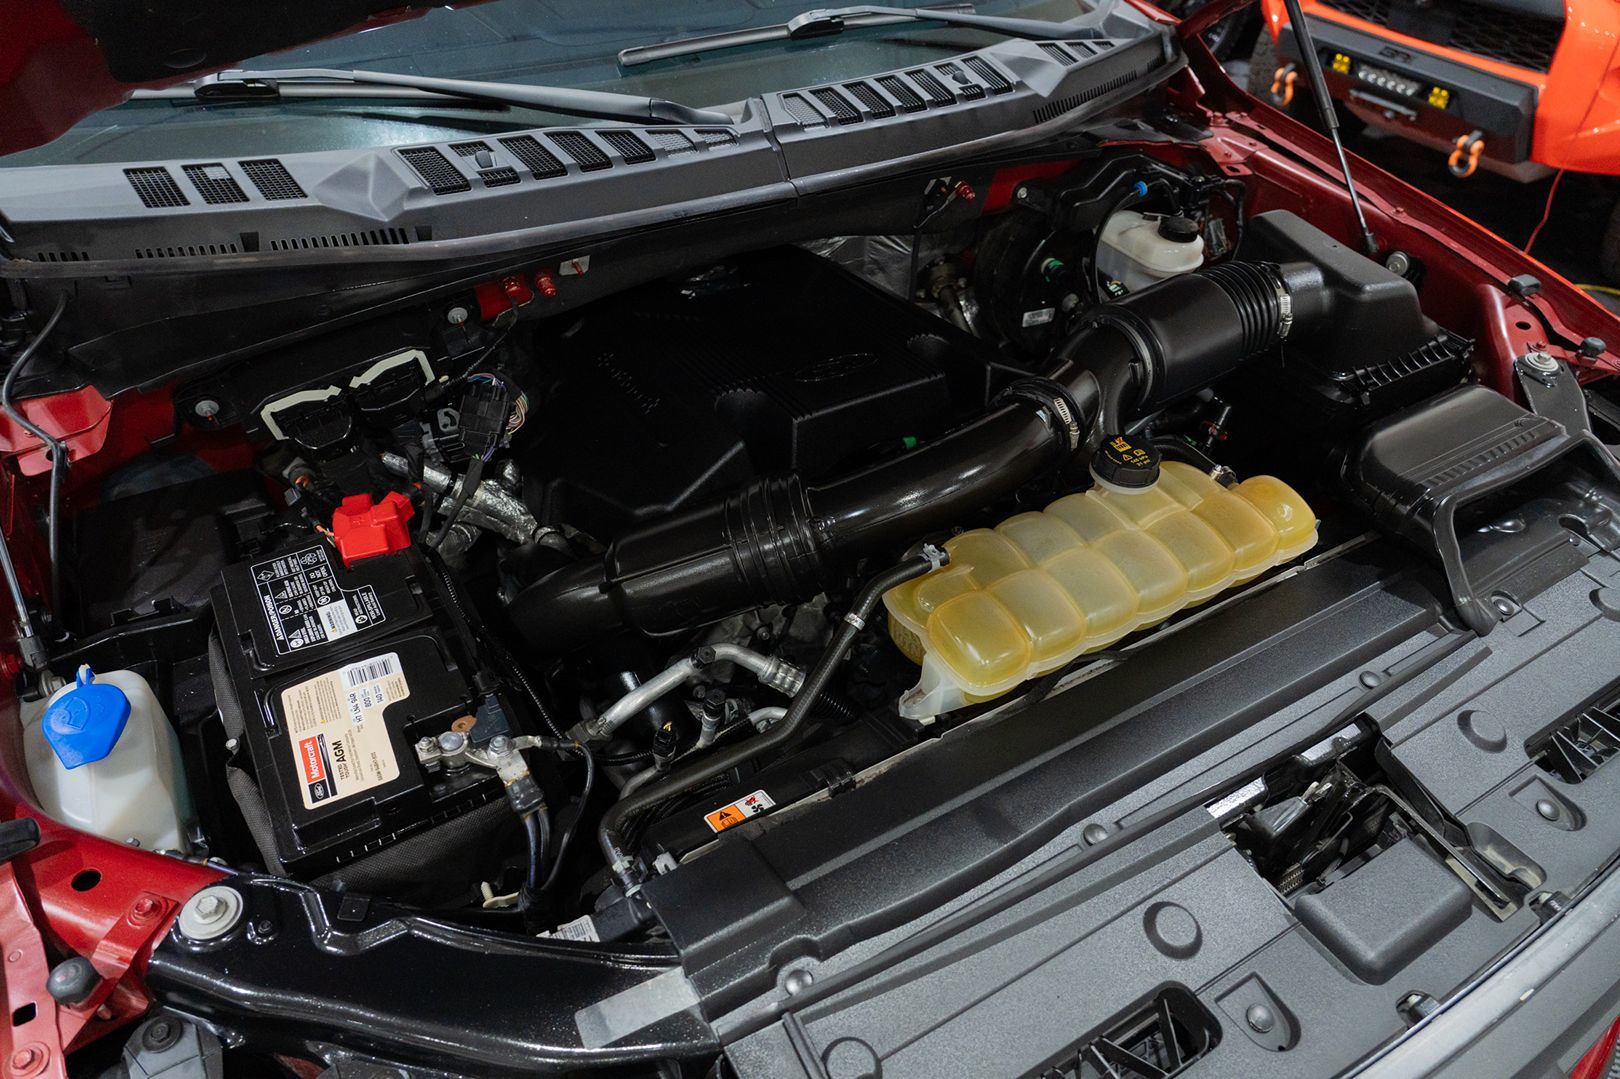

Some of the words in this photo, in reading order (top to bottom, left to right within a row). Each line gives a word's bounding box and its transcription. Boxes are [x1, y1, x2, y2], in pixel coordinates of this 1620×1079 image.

[263, 595, 281, 636] DANGER/POISON
[363, 697, 372, 708] 800
[375, 693, 384, 703] 140
[356, 714, 363, 722] H7
[332, 740, 346, 762] AGM
[304, 741, 320, 778] Motorcraft
